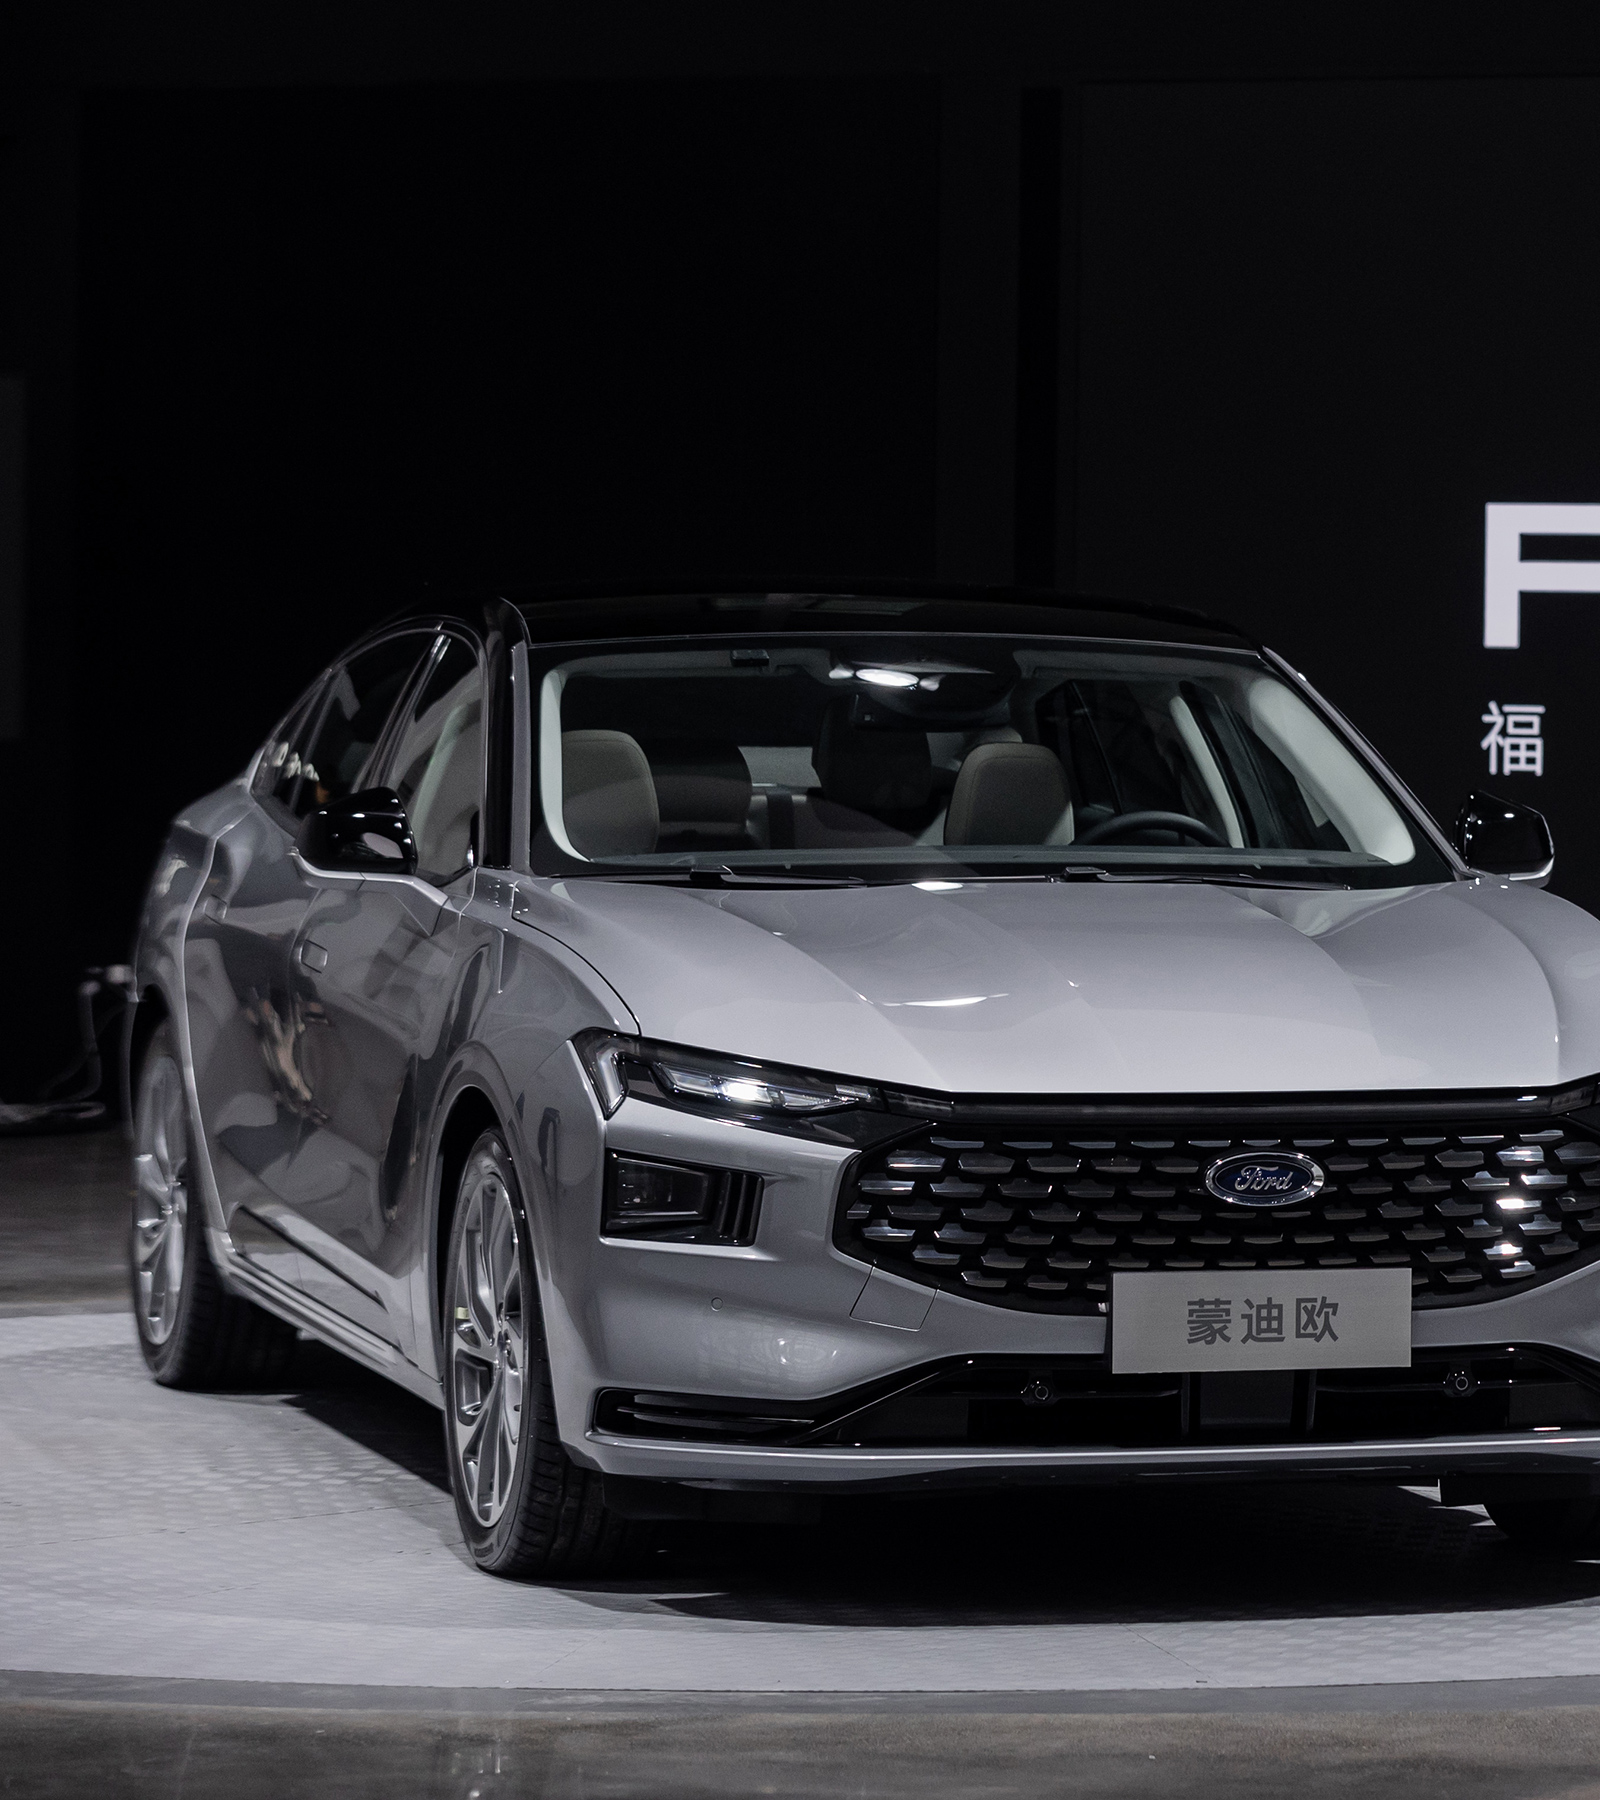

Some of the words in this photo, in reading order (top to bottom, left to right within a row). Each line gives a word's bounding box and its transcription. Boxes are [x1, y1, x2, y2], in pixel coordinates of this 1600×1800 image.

[1234, 1165, 1293, 1191] Ford
[1186, 1296, 1339, 1345] 蒙迪欧
